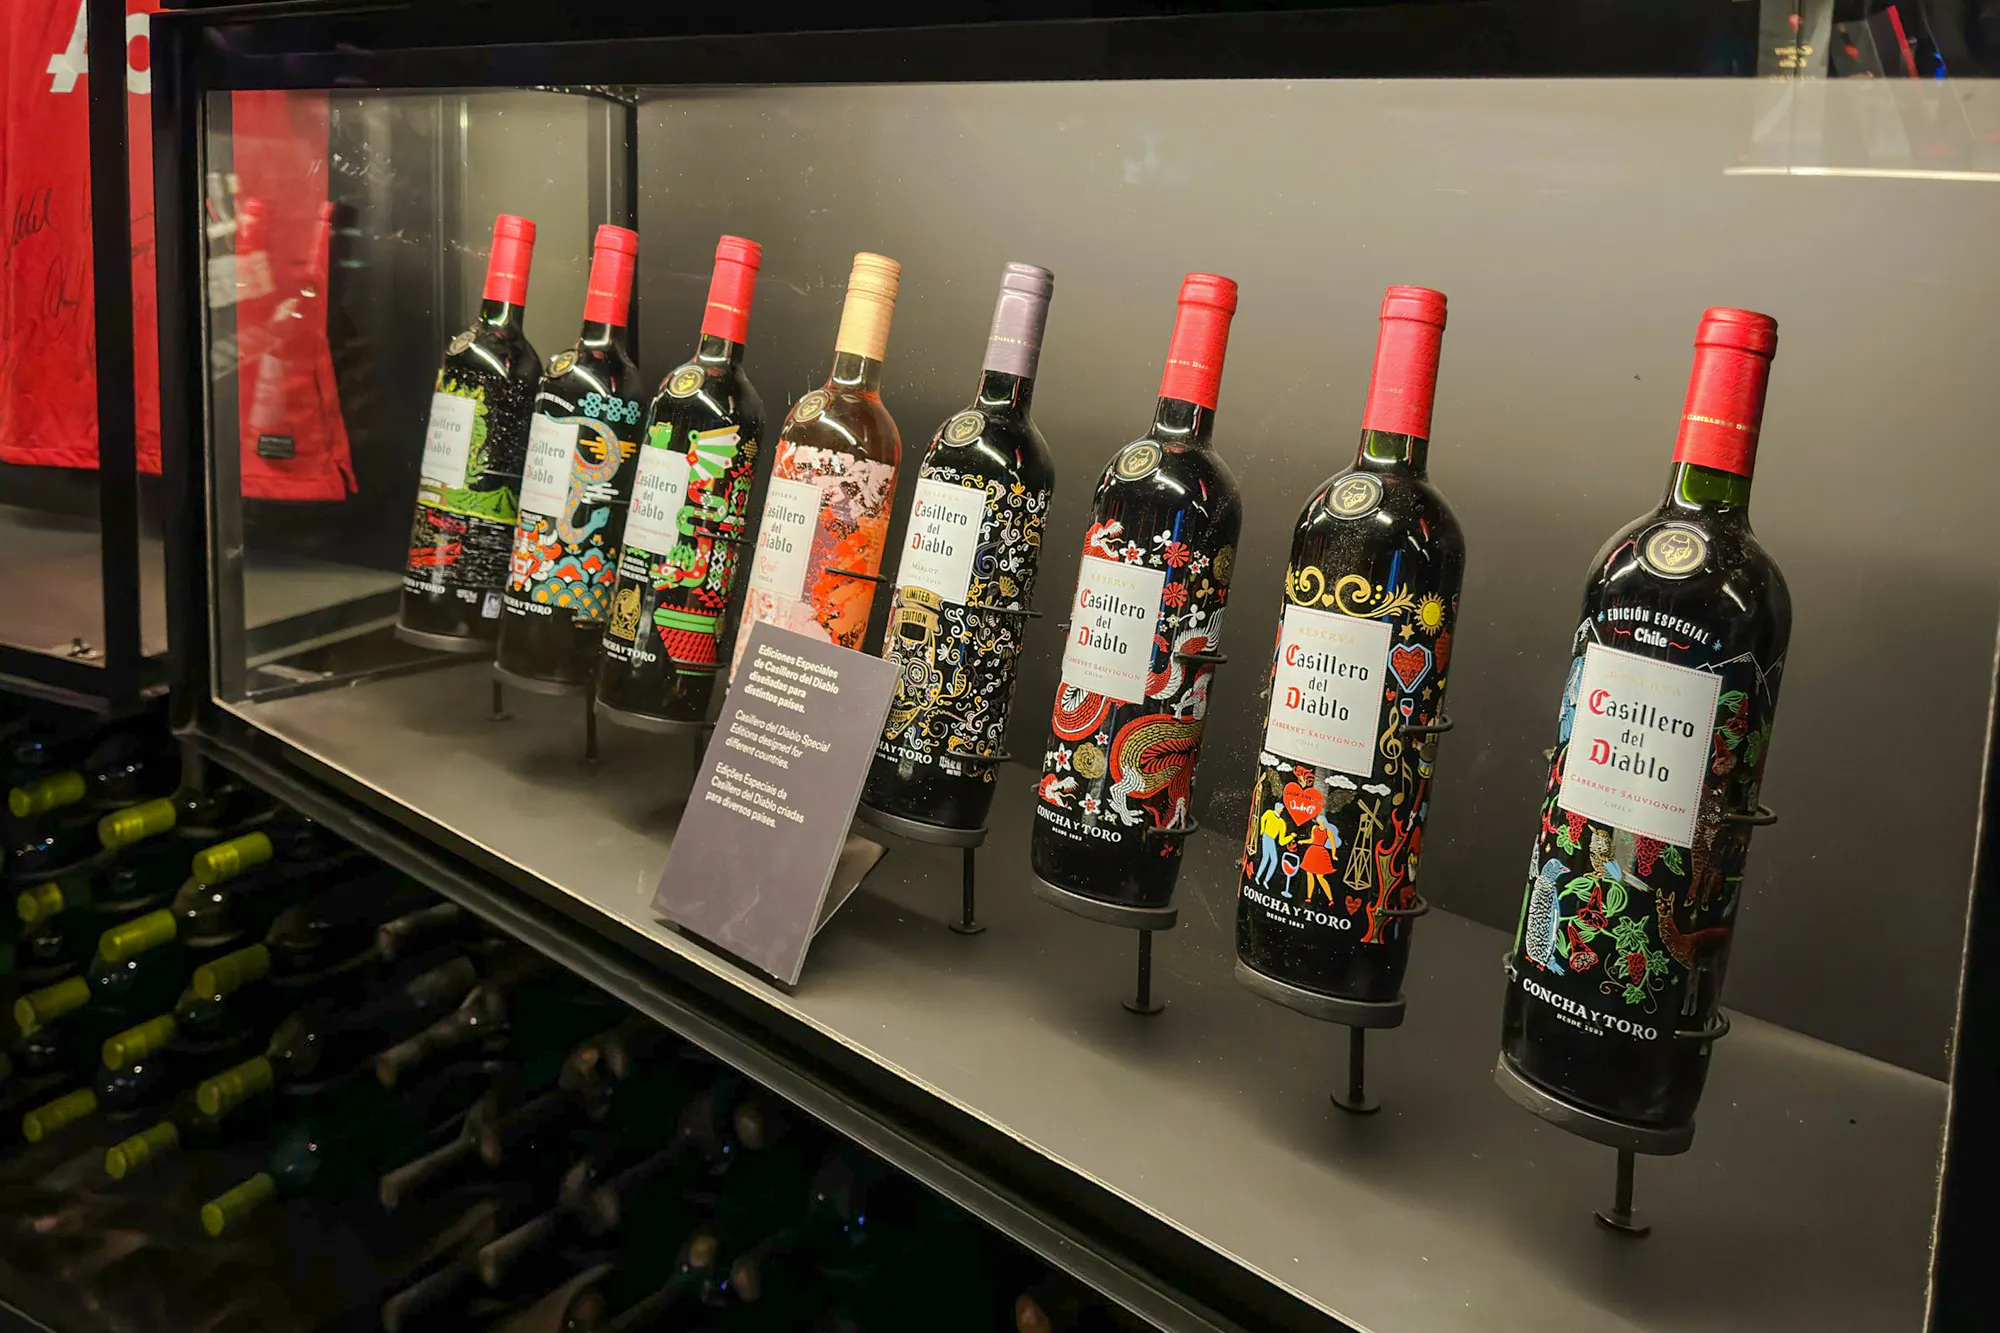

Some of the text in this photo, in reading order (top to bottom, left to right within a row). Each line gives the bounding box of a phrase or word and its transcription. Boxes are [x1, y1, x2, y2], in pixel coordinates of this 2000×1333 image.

[636, 469, 678, 493] Casillero
[642, 490, 654, 501] del
[632, 498, 664, 521] Diablo
[764, 502, 805, 525] Casillero
[914, 500, 968, 526] Casillero
[770, 522, 782, 534] del
[927, 522, 940, 535] del
[760, 532, 792, 553] Diablo
[912, 533, 953, 557] Diablo
[912, 562, 939, 575] MERLOT
[522, 602, 553, 616] TORO
[906, 588, 931, 604] LIMITED
[1080, 588, 1146, 620] Casillero
[902, 610, 928, 624] EDITION
[1095, 615, 1112, 630] del
[1607, 606, 1711, 646] EDICIÓN ESPECIAL
[1078, 626, 1128, 655] Diablo
[1298, 627, 1354, 645] RESERVA
[1633, 626, 1669, 648] Chile
[626, 647, 657, 662] TORO
[758, 644, 839, 679] Ediciones Especiales
[1285, 643, 1369, 682] Casillero
[749, 671, 807, 698] diseñadas para
[753, 658, 840, 695] de Casillero del Diablo
[1093, 664, 1141, 681] SAUVIGNON
[1308, 676, 1328, 692] del
[1611, 670, 1683, 698] RESERVA
[744, 684, 806, 714] distintos países.
[1285, 686, 1349, 721] Diablo
[1588, 689, 1695, 738] Casillero
[729, 722, 804, 758] Editions designed for
[735, 709, 831, 753] Casillero del Diablo Special
[1271, 719, 1365, 749] CABERNET SAUVIGNON
[1621, 729, 1644, 748] del
[725, 736, 789, 770] different countries.
[898, 746, 932, 765] TORO
[1588, 738, 1669, 782] Diablo
[715, 762, 788, 801] Edições Especiais da
[1570, 774, 1686, 815] CABERNET SAUVIGNON
[705, 791, 777, 828] para diversos países.
[711, 776, 804, 824] Casillero del Diablo criadas
[1604, 800, 1632, 813] CHILE
[1037, 804, 1122, 843] CONCHA Y TORO
[1243, 885, 1352, 931] CONCHA Y TORO
[1522, 978, 1658, 1041] CONCHA Y TORO
[1556, 1012, 1581, 1029] DESDE
